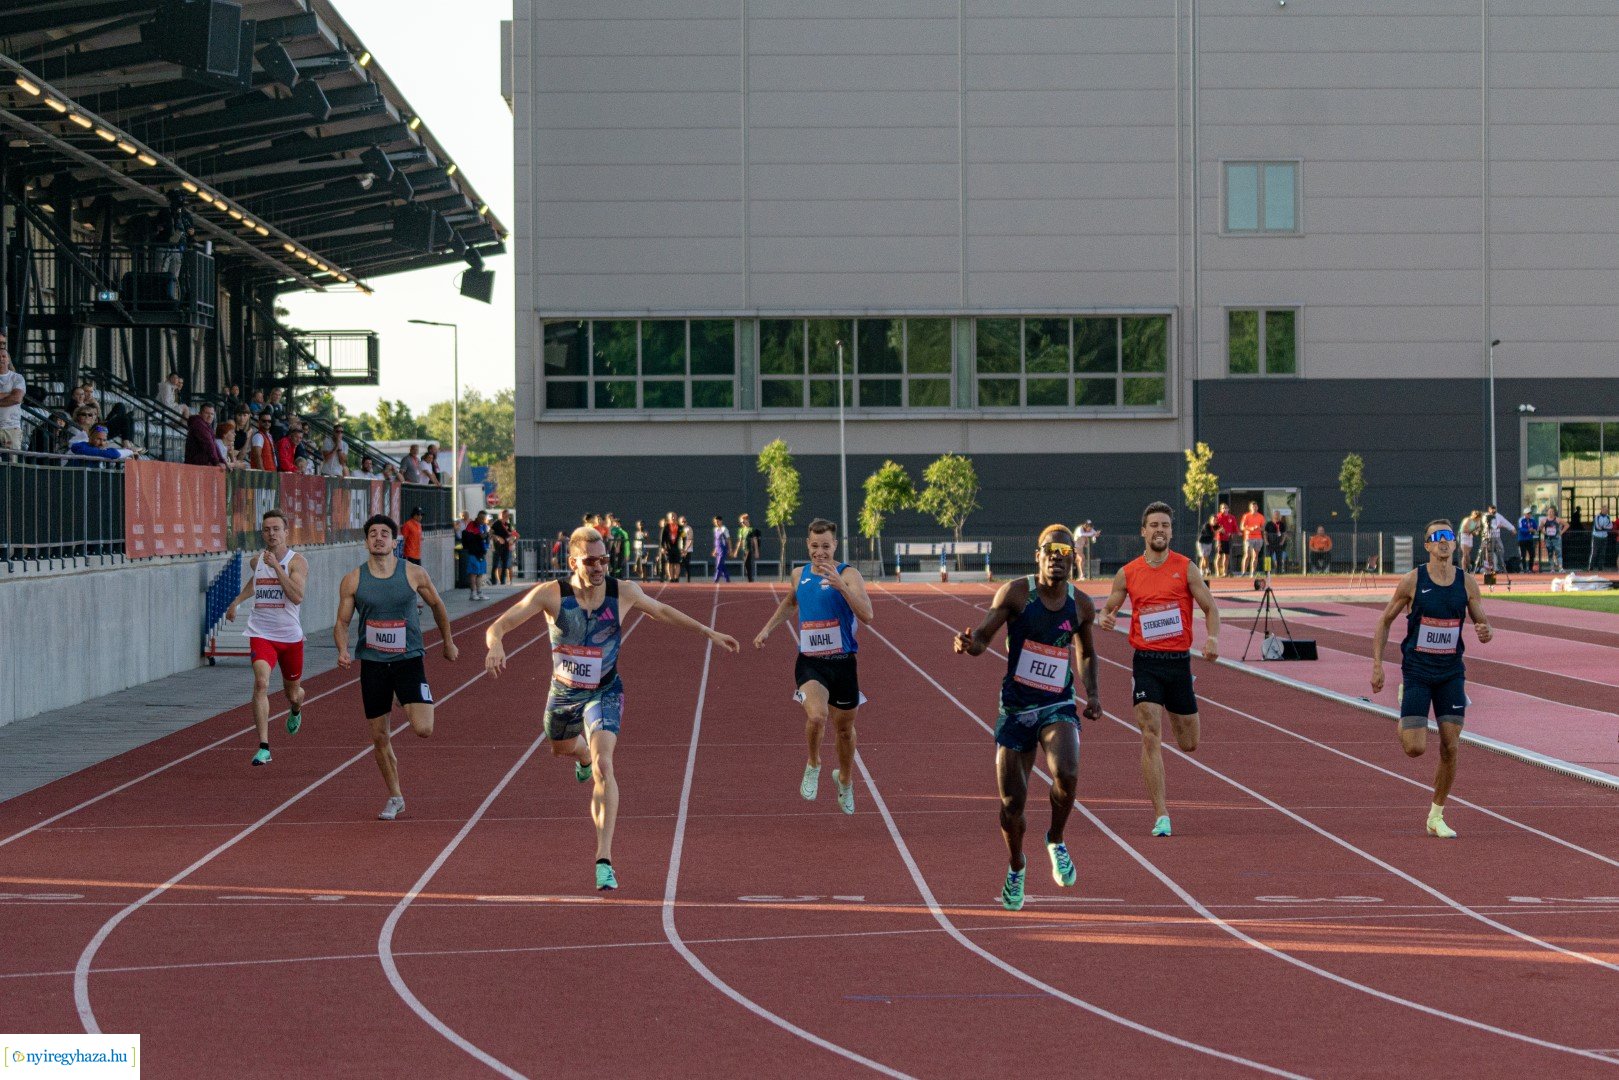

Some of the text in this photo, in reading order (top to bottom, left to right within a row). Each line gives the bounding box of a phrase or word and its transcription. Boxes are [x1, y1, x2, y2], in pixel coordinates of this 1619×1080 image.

[1143, 616, 1180, 630] STEIGERWALD
[376, 633, 396, 644] NADJ
[809, 634, 833, 647] WAHL
[1427, 632, 1452, 644] BUJNA
[563, 660, 592, 678] PARGE
[1030, 660, 1058, 679] FELIZ
[1253, 894, 1384, 903] 3
